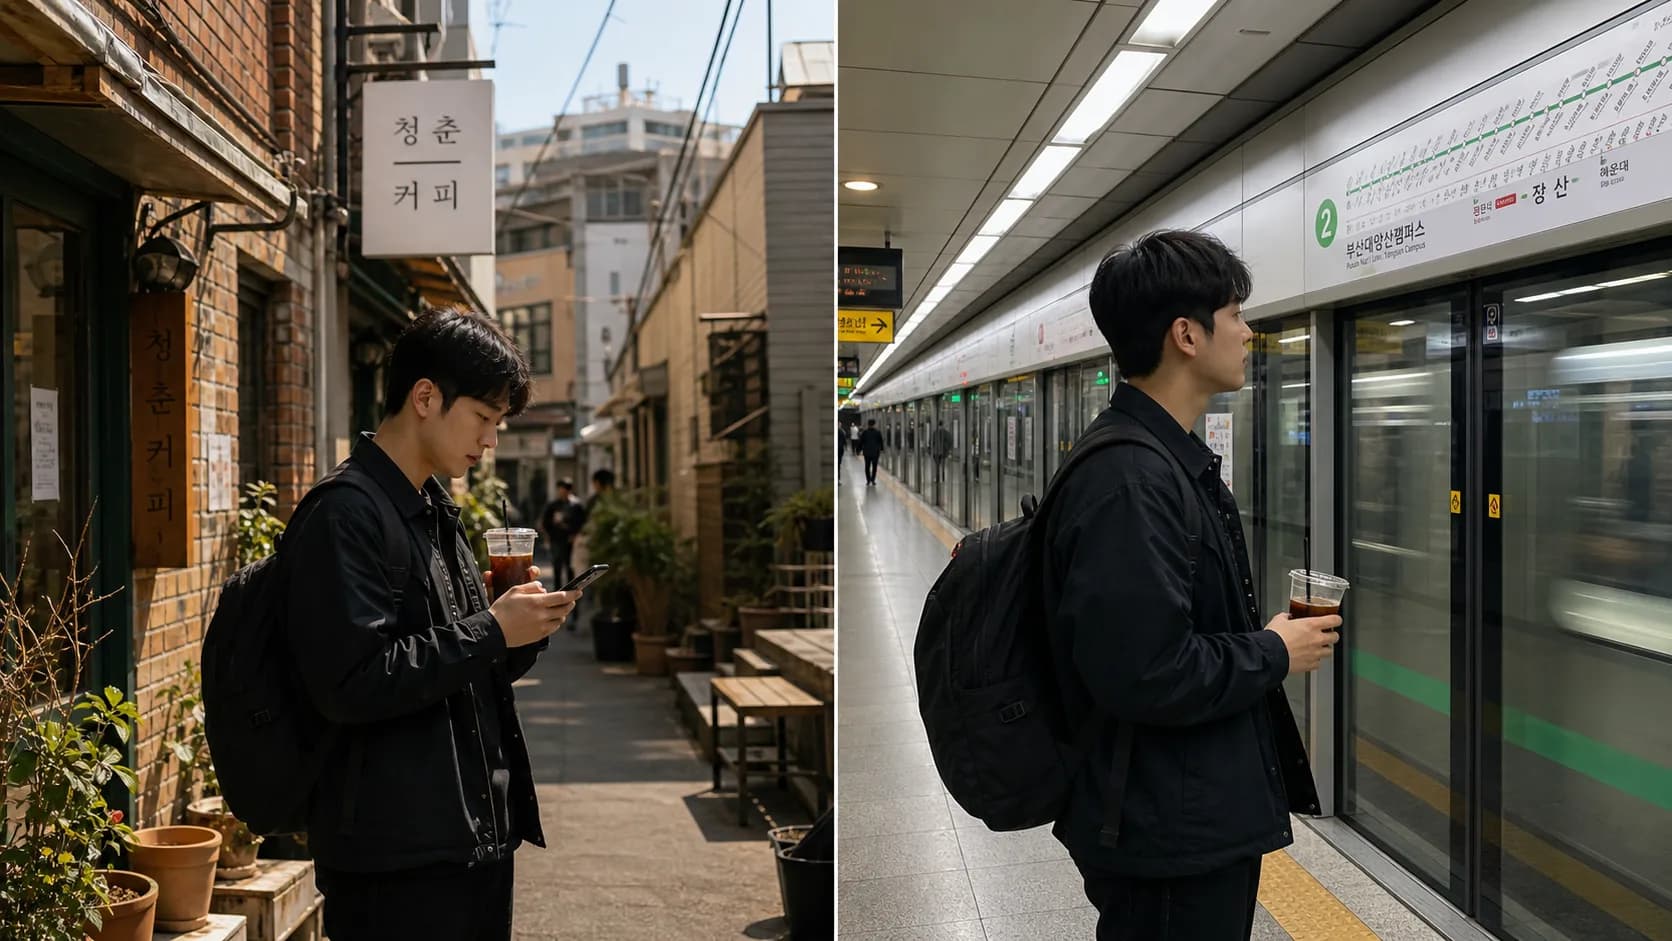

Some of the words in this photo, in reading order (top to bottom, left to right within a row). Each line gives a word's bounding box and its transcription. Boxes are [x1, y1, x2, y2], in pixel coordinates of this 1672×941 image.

[394, 115, 462, 146] 청춘
[394, 179, 459, 211] 커피
[1532, 175, 1569, 205] 장산
[1321, 208, 1332, 239] 2
